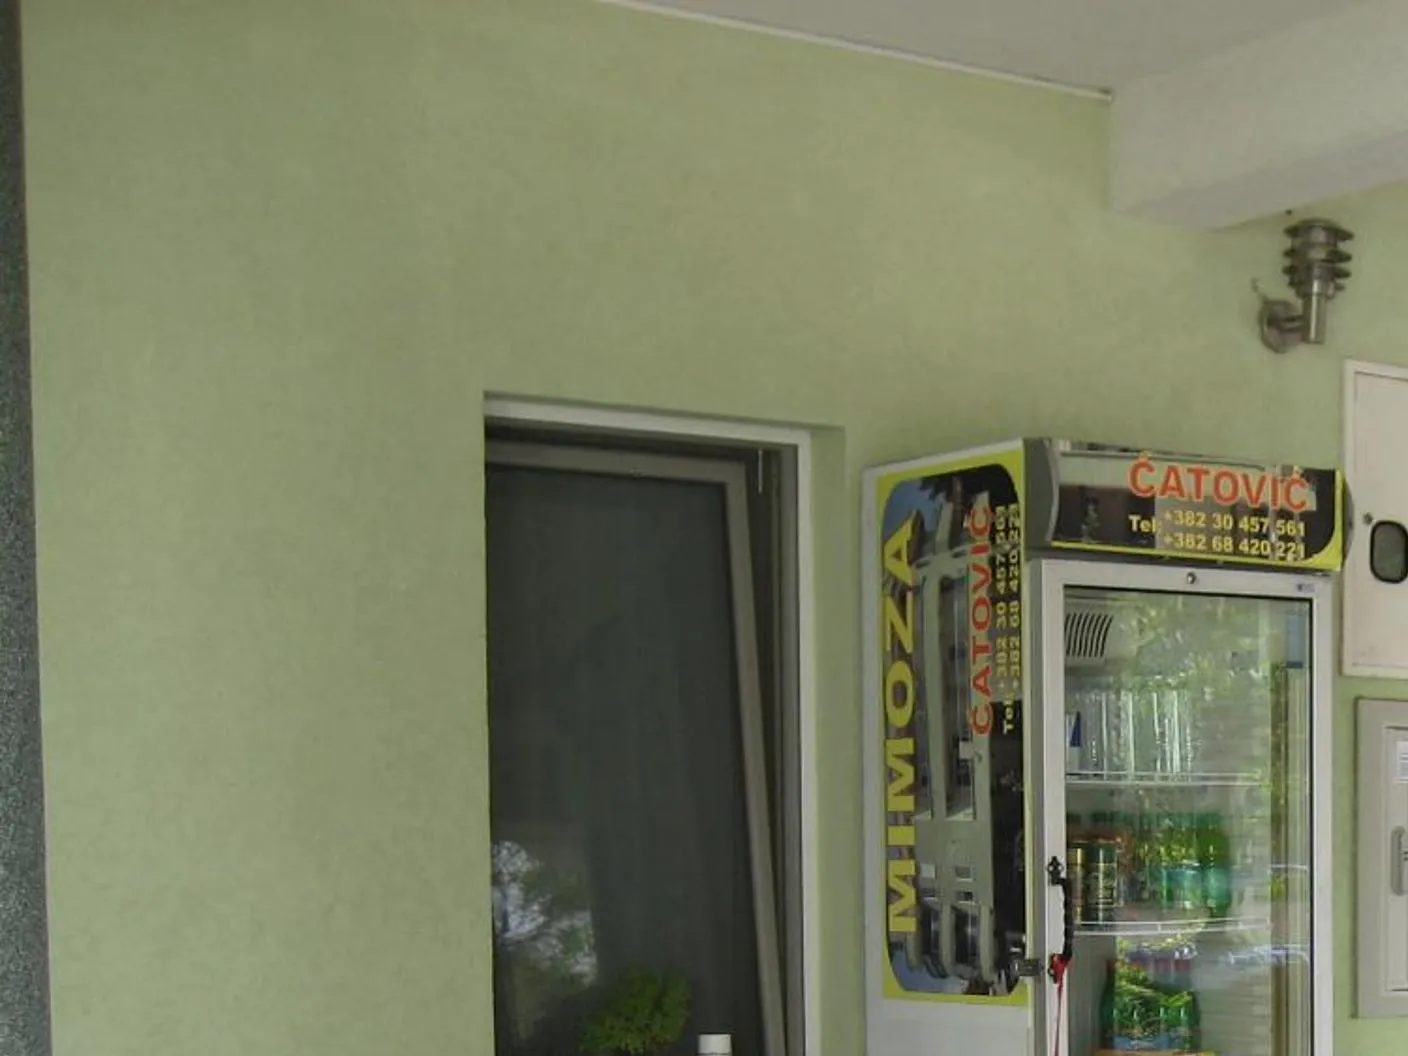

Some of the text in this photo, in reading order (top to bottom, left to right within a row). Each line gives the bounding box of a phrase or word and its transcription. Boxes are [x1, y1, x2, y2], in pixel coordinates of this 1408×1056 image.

[1163, 509, 1305, 537] +382 30 457 561
[1163, 532, 1207, 551] +382
[1211, 536, 1233, 553] 68
[1239, 539, 1270, 557] 420
[996, 602, 1008, 630] 30
[883, 508, 917, 933] MIMOZA
